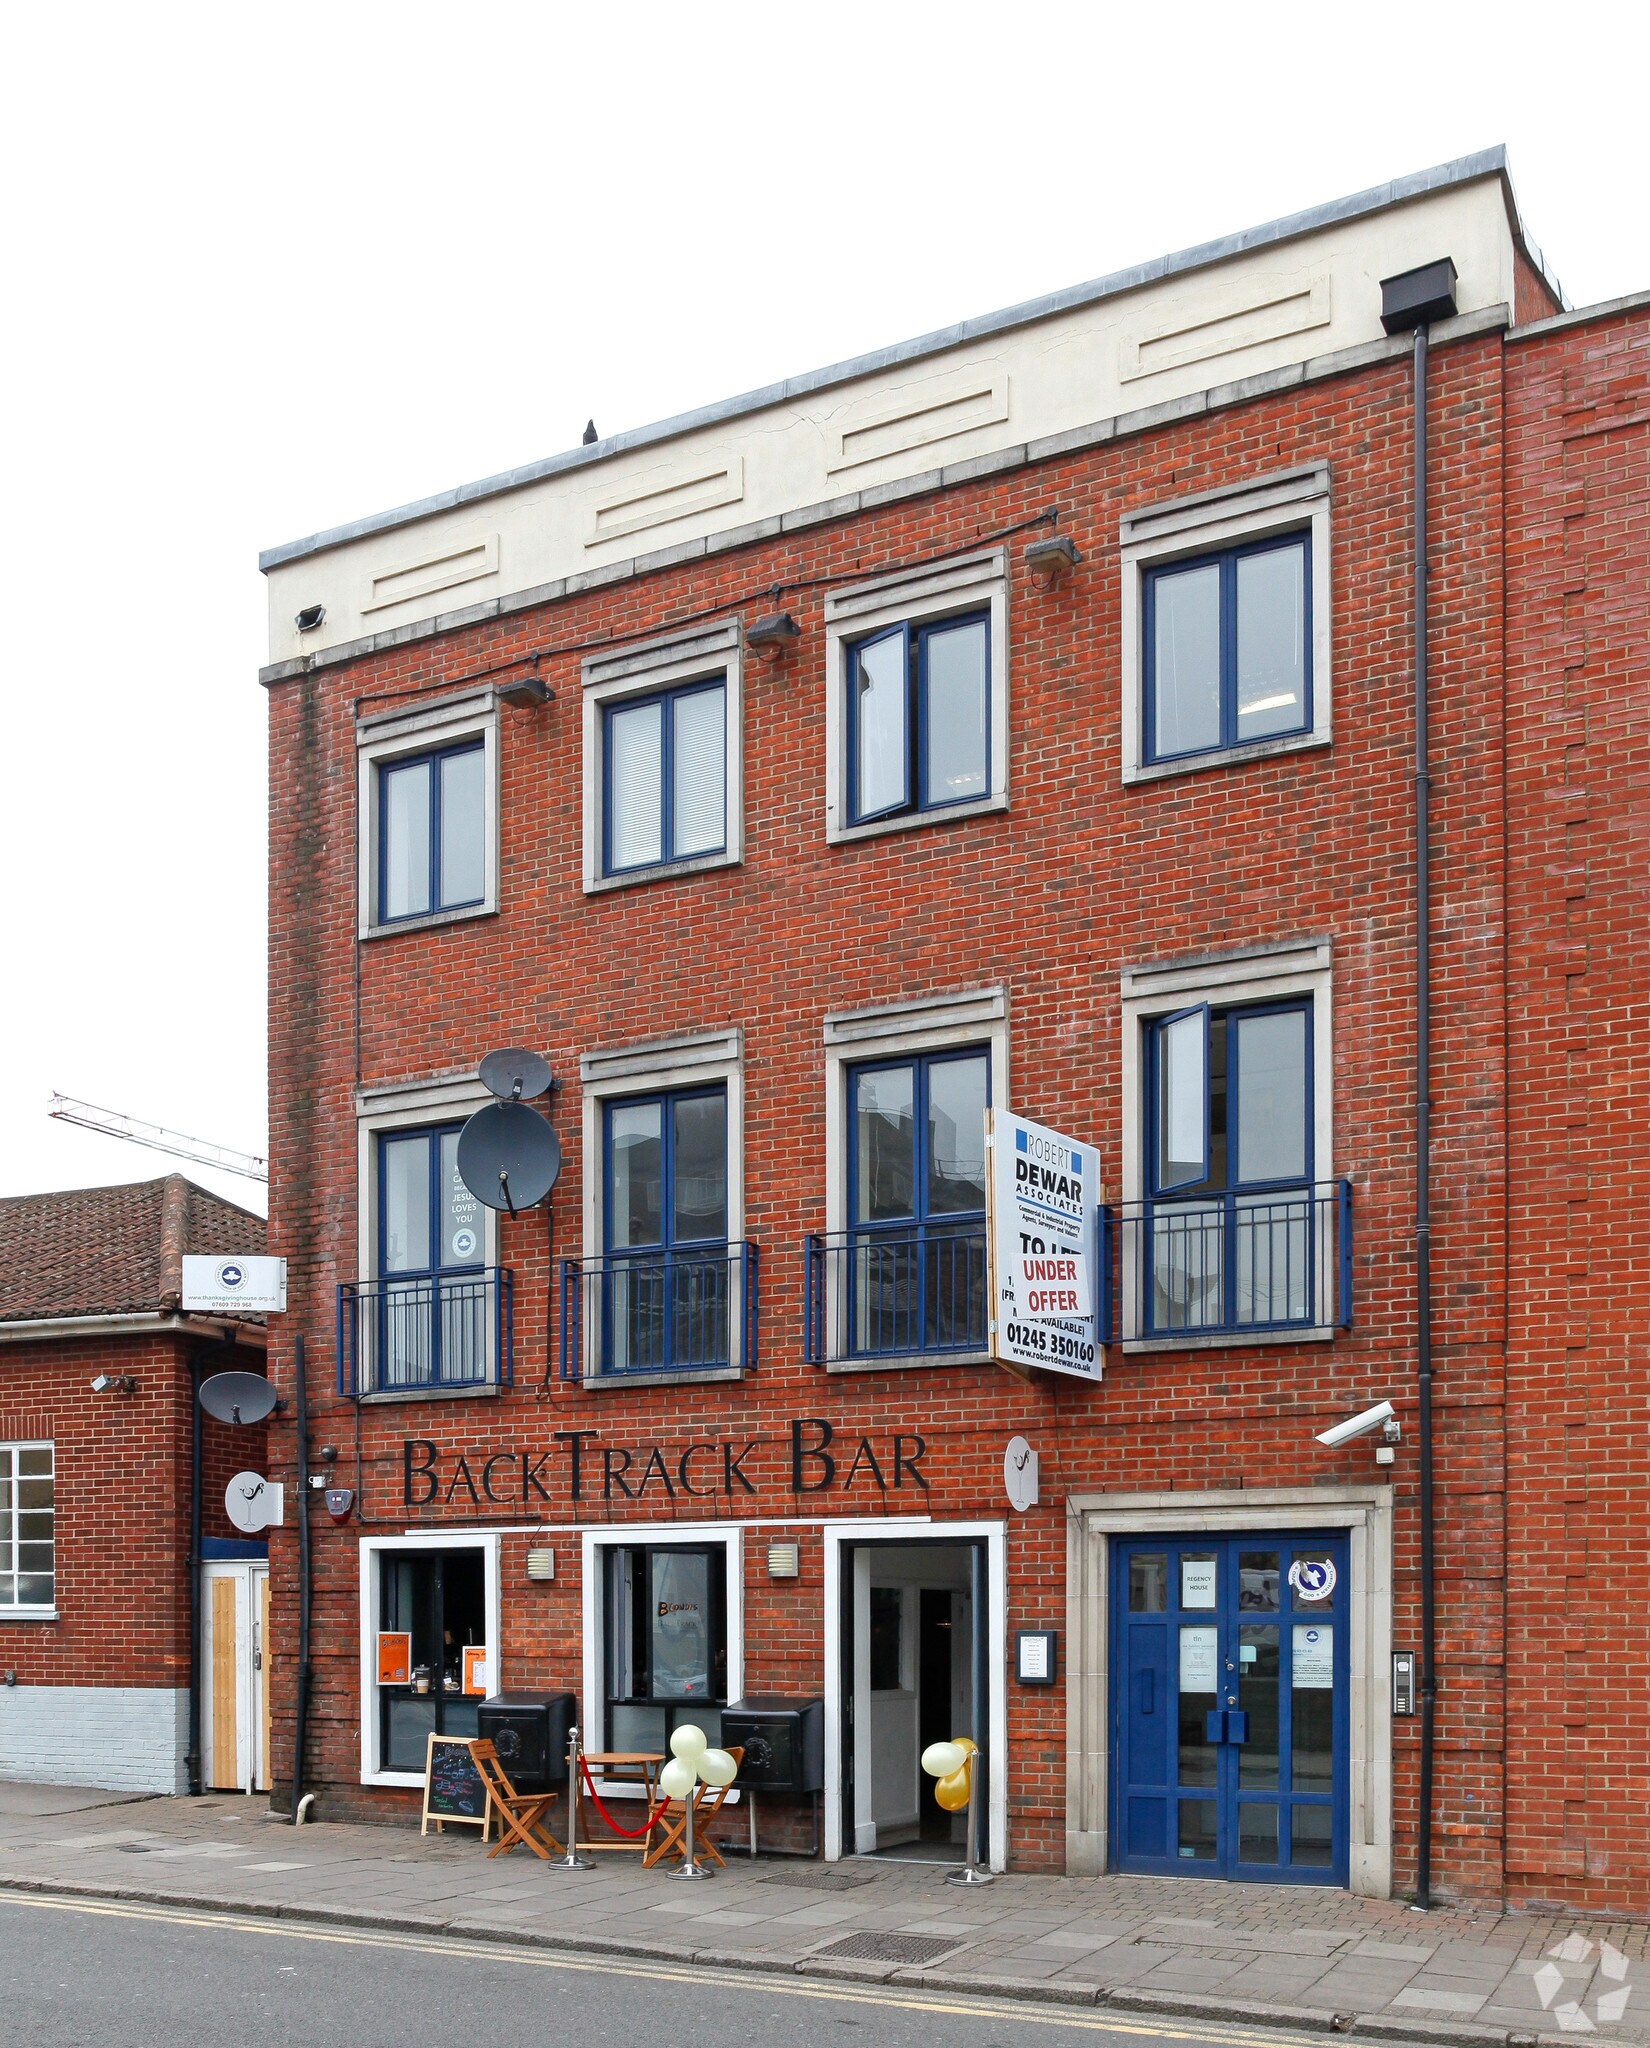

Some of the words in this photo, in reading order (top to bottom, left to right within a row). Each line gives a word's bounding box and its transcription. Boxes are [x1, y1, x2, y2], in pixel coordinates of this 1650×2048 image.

[1029, 1134, 1070, 1170] ROBERT
[1016, 1158, 1082, 1203] DEWAR
[452, 1203, 477, 1213] LOVES
[1016, 1183, 1083, 1216] ASSOCIATES
[456, 1214, 473, 1223] YOU
[1019, 1231, 1045, 1255] TO
[1023, 1260, 1077, 1281] UNDER
[1028, 1290, 1079, 1311] OFFER
[1007, 1323, 1046, 1351] 01245
[1050, 1334, 1095, 1363] 350160
[1012, 1347, 1091, 1373] www.robertdewar.co.uk
[792, 1419, 930, 1493] BAR
